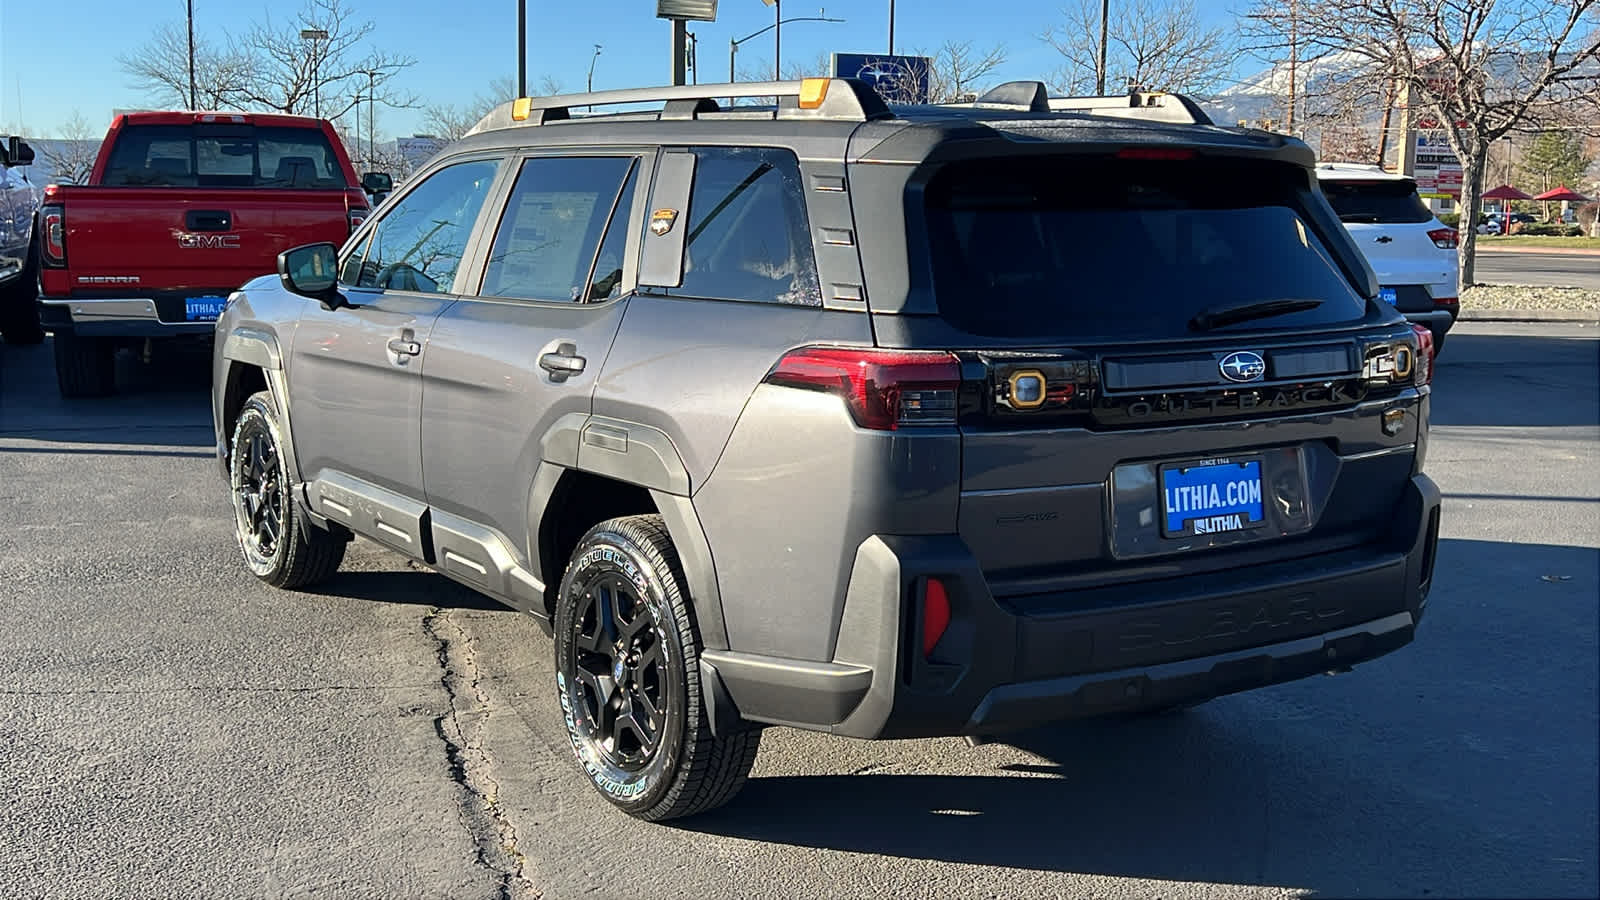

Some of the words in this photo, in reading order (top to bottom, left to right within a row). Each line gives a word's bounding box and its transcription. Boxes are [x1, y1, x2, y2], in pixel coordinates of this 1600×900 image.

[178, 234, 241, 249] GMC
[186, 303, 225, 314] LITHIA.C
[1127, 386, 1348, 417] OUTBACK
[1165, 479, 1261, 513] LITHIA.COM
[1206, 515, 1243, 533] LITHIA
